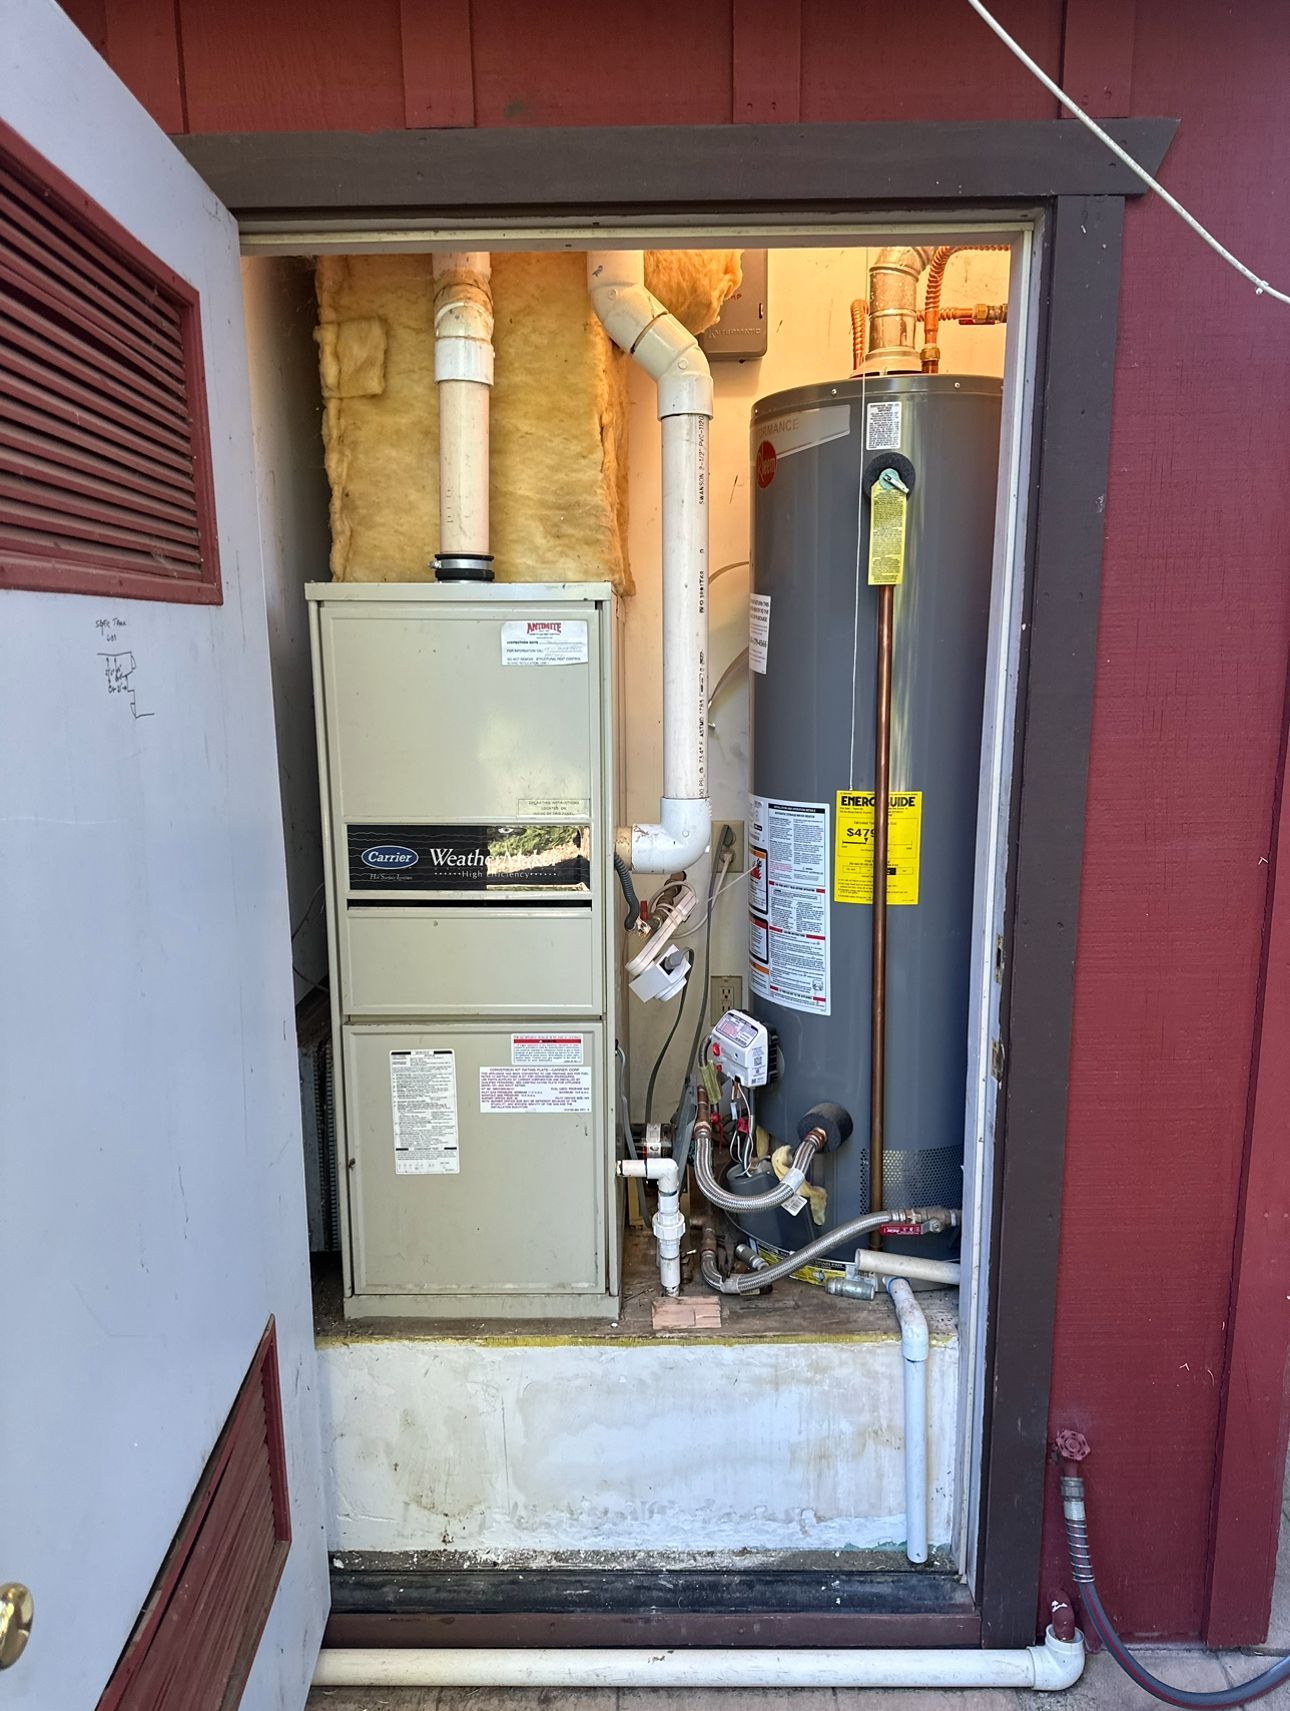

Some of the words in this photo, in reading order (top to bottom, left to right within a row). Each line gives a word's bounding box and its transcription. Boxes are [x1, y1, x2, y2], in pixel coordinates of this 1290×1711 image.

[758, 452, 775, 482] Rheem
[526, 622, 562, 634] ANTIMITE
[367, 851, 413, 863] Carrier
[461, 870, 483, 879] High
